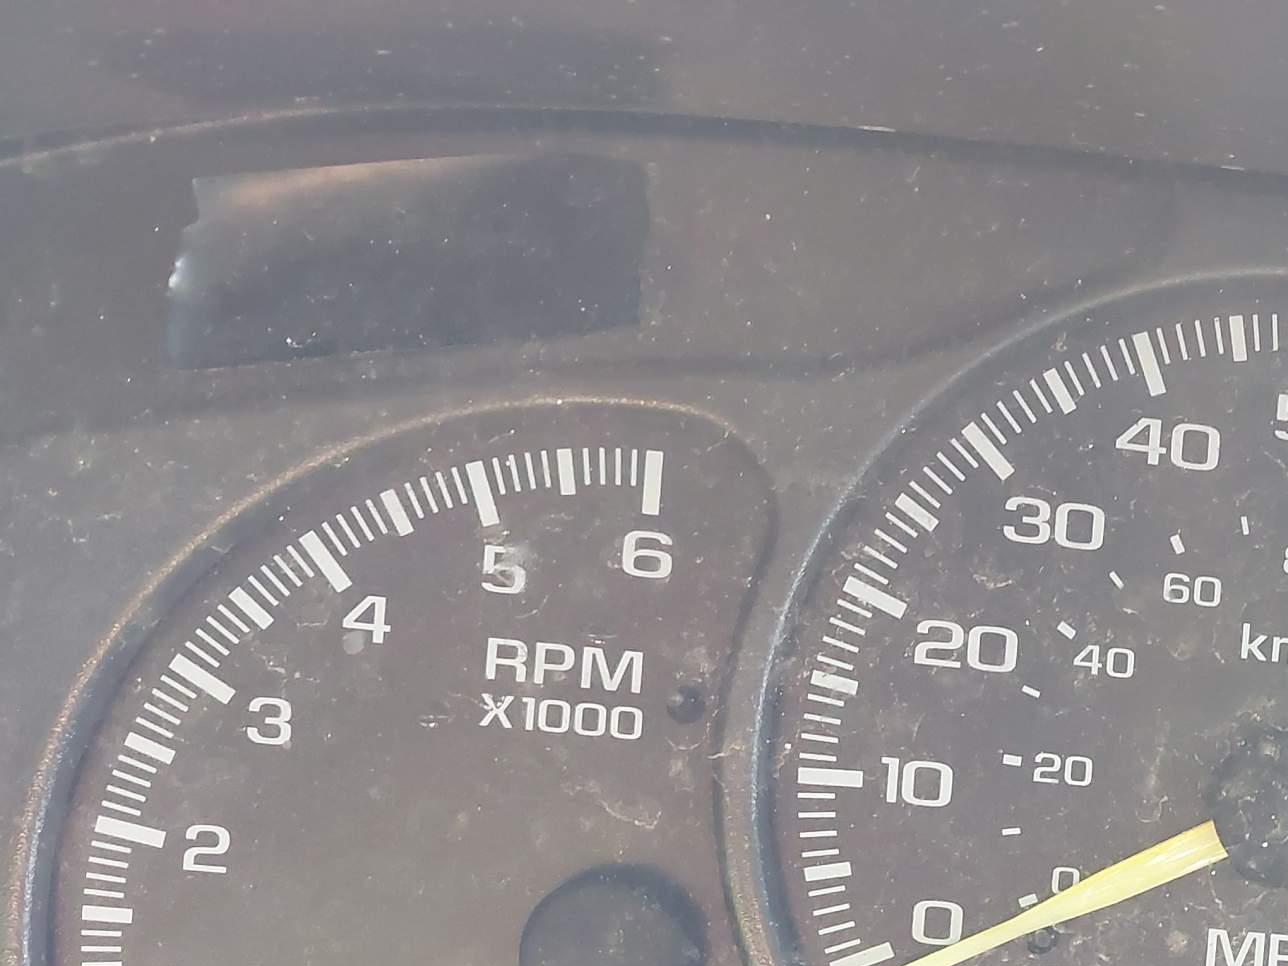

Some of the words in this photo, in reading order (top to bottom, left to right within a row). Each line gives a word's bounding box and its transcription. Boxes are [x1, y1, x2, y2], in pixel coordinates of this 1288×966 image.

[1115, 417, 1220, 471] 40
[1003, 496, 1105, 551] 30
[481, 544, 526, 594] 5
[622, 530, 673, 580] 6
[1163, 573, 1222, 608] 60
[342, 595, 391, 644] 4
[485, 637, 644, 694] RPM
[913, 620, 1018, 673] 20
[1073, 644, 1135, 679] 40
[246, 697, 293, 746] 3
[478, 692, 644, 740] X1000
[881, 756, 954, 808] 10
[1032, 752, 1093, 787] 20
[182, 824, 231, 874] 2
[1051, 866, 1080, 894] 0
[912, 900, 963, 946] 0
